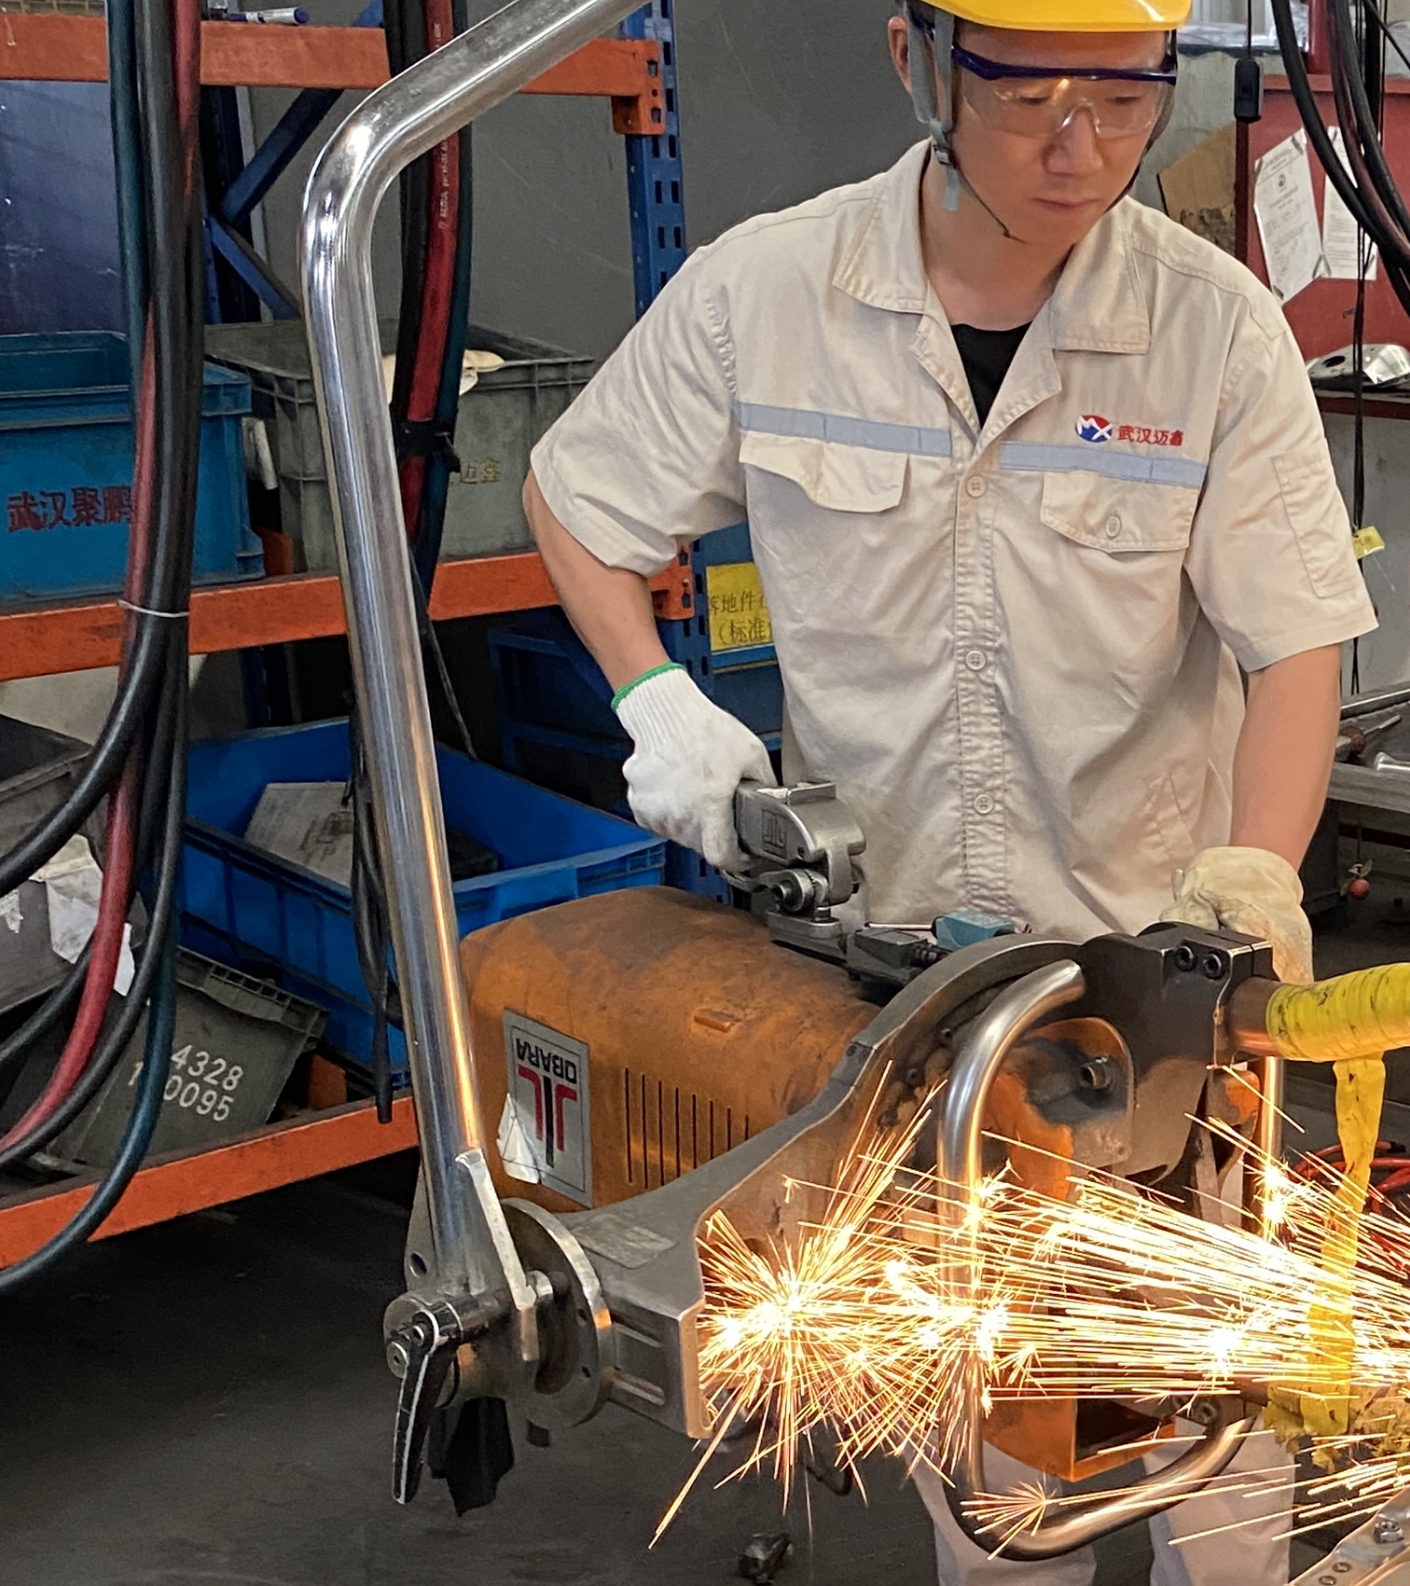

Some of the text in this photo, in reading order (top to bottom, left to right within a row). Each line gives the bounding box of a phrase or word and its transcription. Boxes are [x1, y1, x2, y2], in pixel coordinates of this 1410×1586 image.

[1117, 425, 1184, 447] 武汉迈鑫
[7, 486, 133, 532] 武汉聚鹏
[171, 1044, 244, 1091] 4328
[516, 1038, 577, 1084] OBARA
